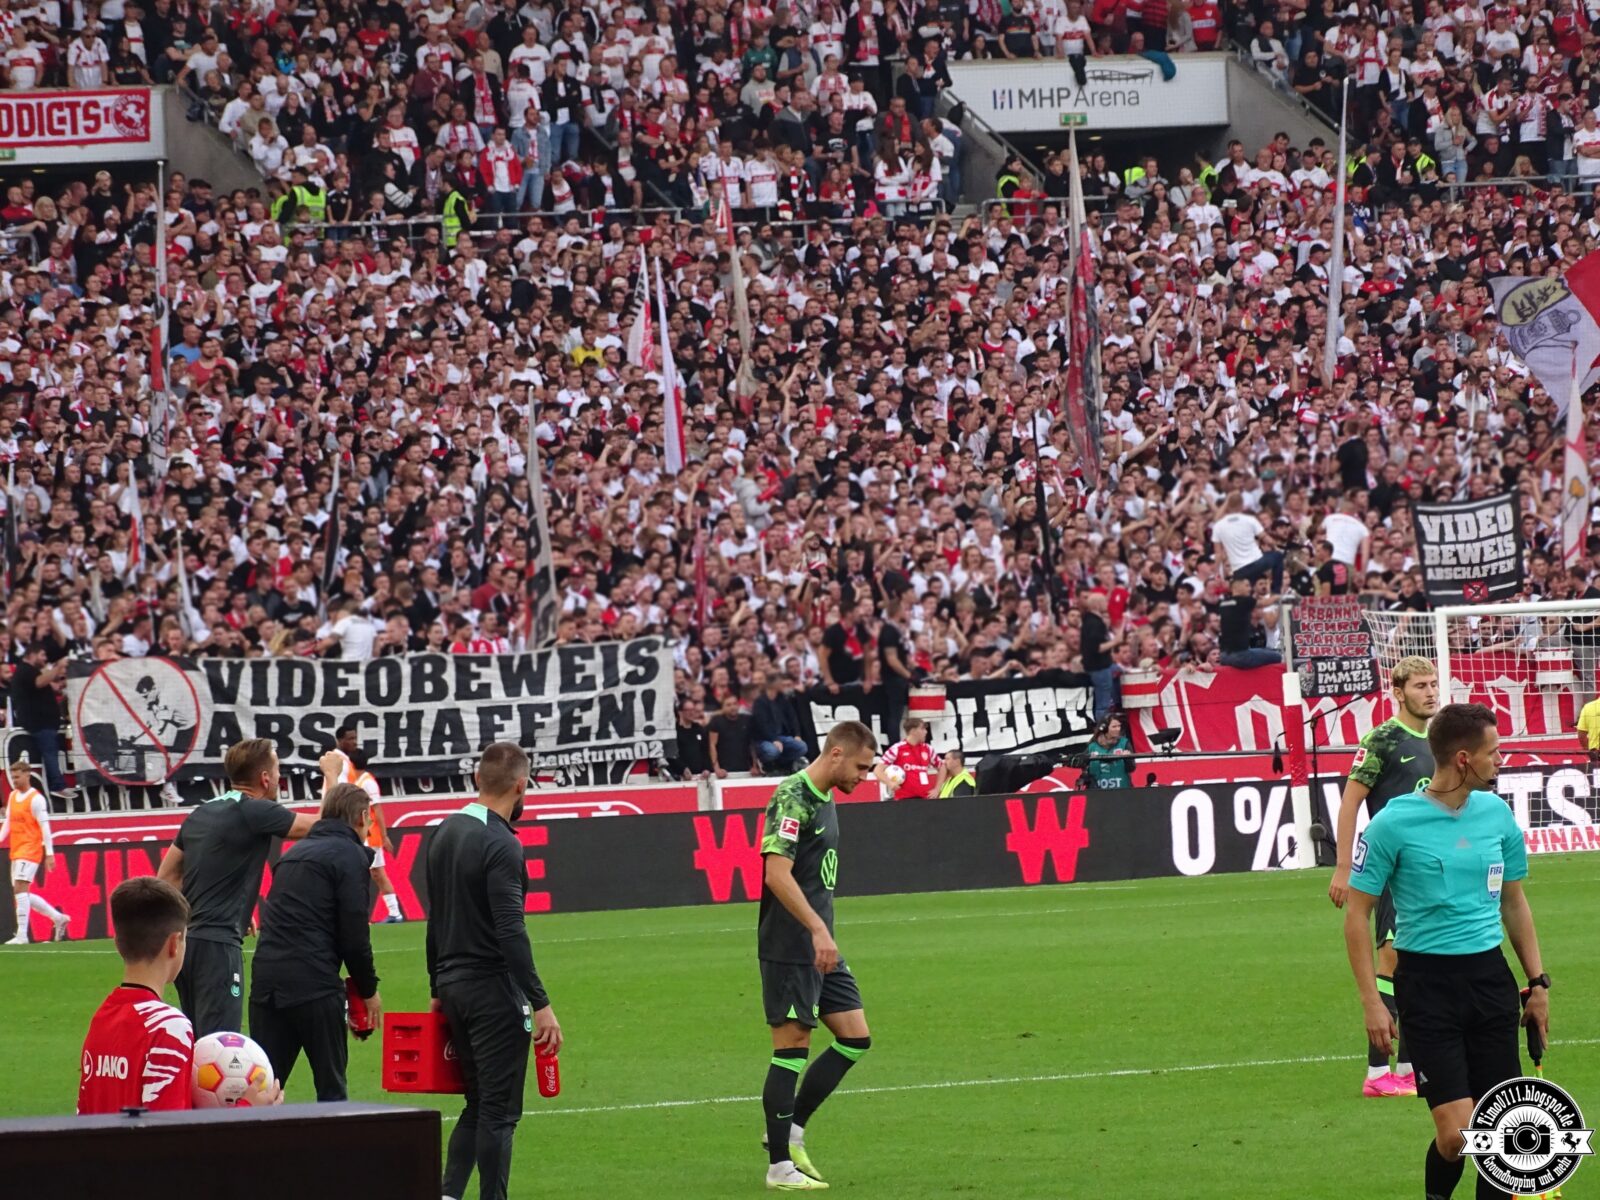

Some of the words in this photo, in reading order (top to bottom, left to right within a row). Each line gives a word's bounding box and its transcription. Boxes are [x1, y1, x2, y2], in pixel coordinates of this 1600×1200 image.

[1018, 87, 1070, 109] MHP
[1073, 85, 1140, 108] Arena
[1418, 503, 1514, 542] VIDEO
[1422, 533, 1516, 566] BEWEIS
[1426, 557, 1515, 582] ABSCHAFFEN
[1300, 620, 1361, 633] KEHRT
[203, 639, 662, 707] VIDEOBEWEIS
[1317, 661, 1337, 672] DU
[1342, 659, 1371, 671] BIST
[1318, 669, 1373, 684] IMMER
[1318, 684, 1339, 694] BEI
[1343, 680, 1374, 692] UNS!
[204, 689, 656, 760] ABSCHAFFEN!
[1097, 778, 1122, 789] OST
[1170, 789, 1216, 876] 0
[95, 1054, 128, 1080] JAKO
